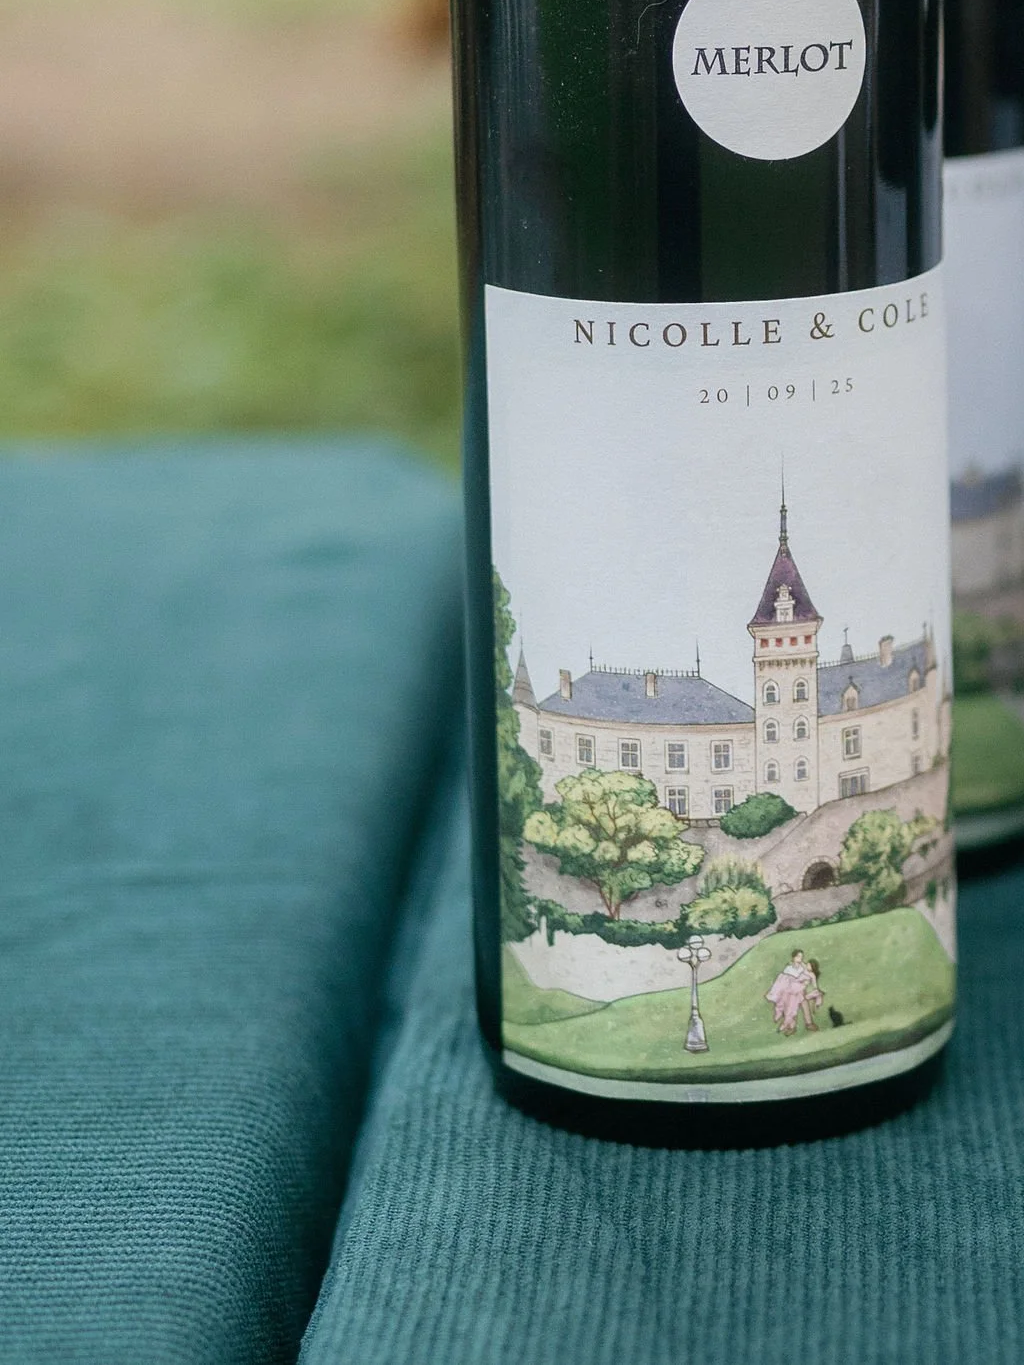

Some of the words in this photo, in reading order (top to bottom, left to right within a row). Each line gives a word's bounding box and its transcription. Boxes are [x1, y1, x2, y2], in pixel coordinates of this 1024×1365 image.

[690, 39, 853, 77] MERLOT
[574, 319, 783, 347] NICOLLE
[809, 312, 835, 340] &
[858, 293, 931, 334] COLE
[699, 388, 729, 404] 20
[767, 384, 796, 401] 09
[831, 378, 855, 394] 25
